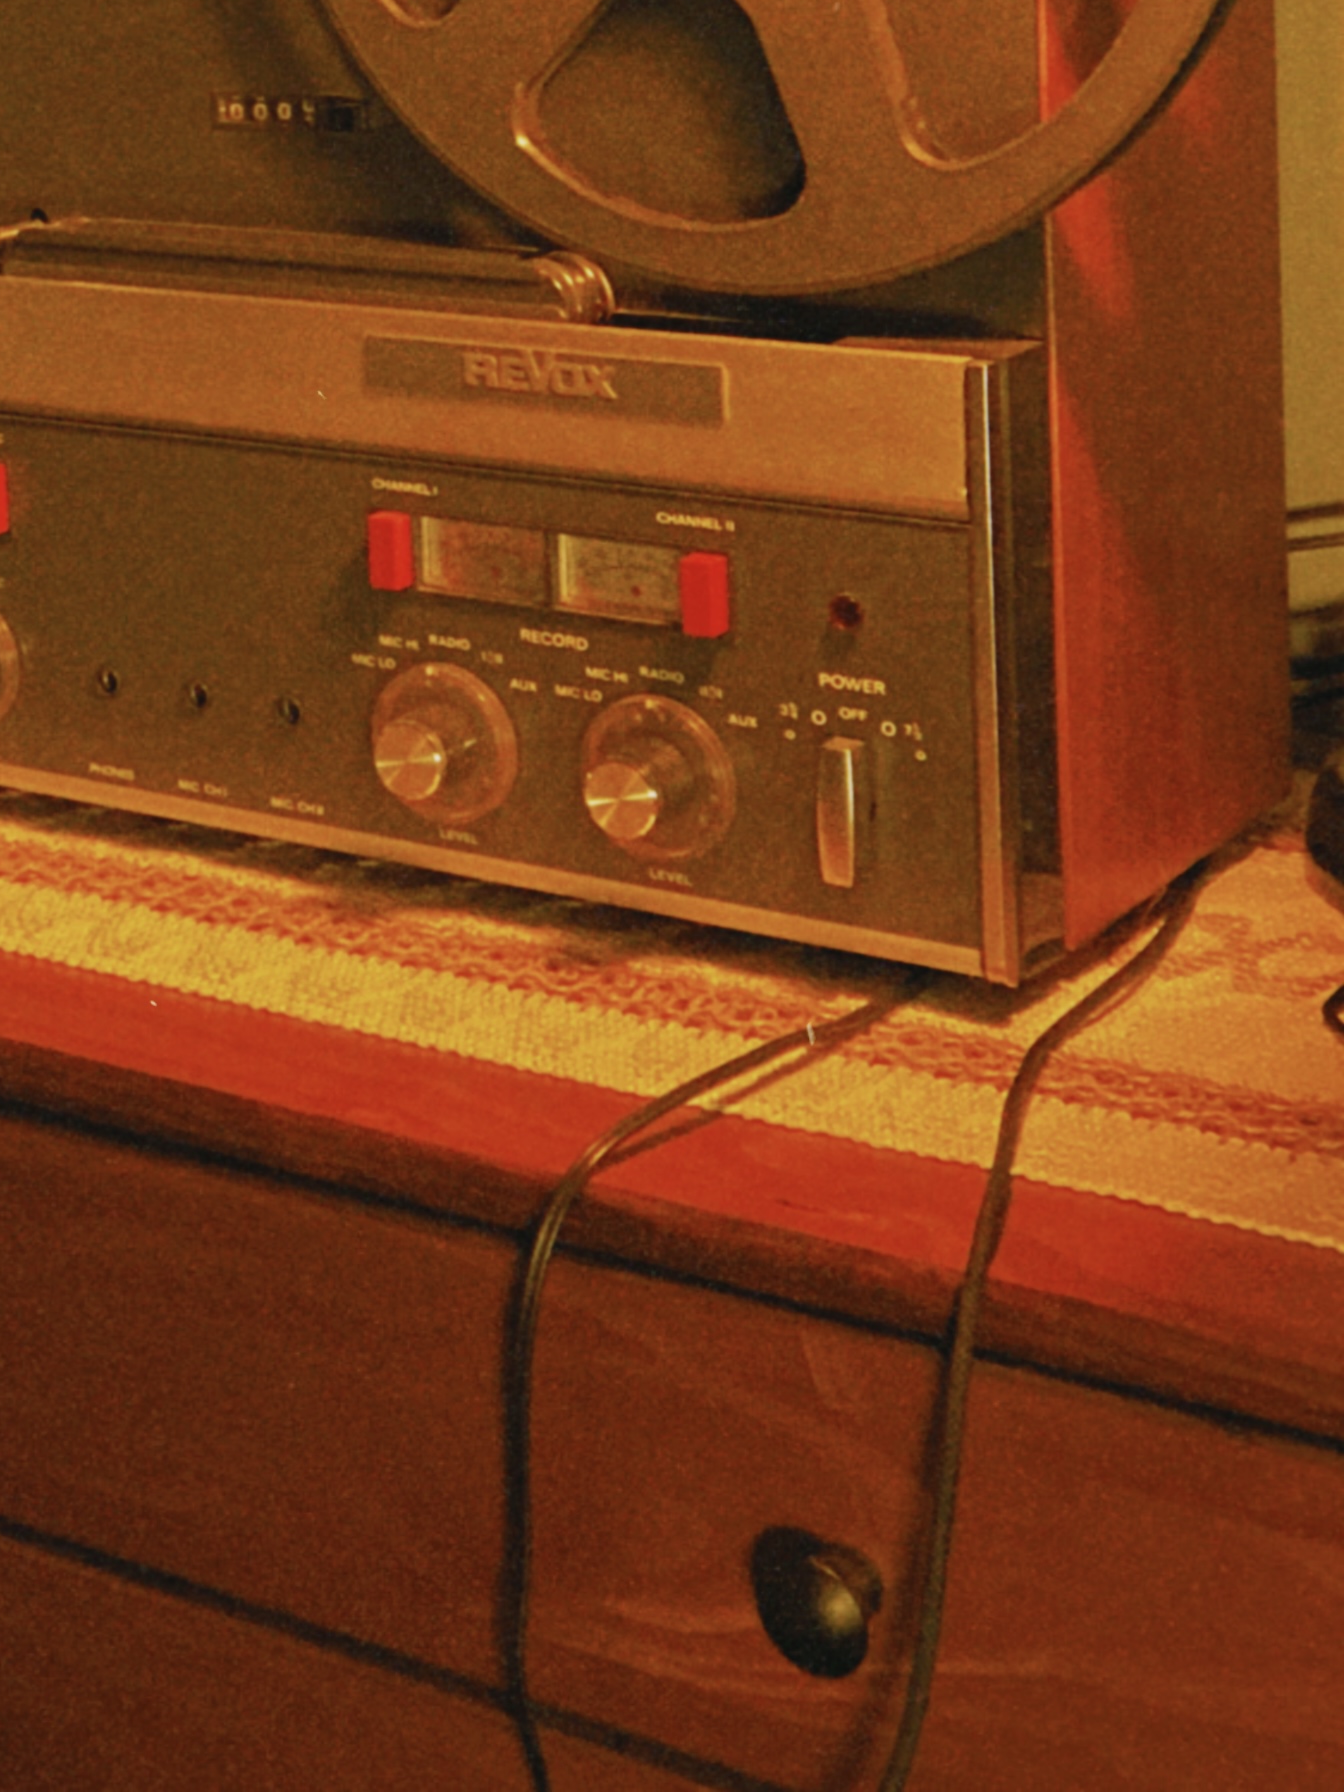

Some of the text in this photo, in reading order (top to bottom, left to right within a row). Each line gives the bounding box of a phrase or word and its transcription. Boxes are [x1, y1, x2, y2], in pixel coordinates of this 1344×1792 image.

[462, 347, 619, 400] REVOX
[371, 476, 430, 496] CHANNEL
[656, 510, 722, 532] CHANNEL
[378, 634, 403, 649] MIC
[428, 633, 472, 651] RADIO
[519, 627, 589, 652] RECORD
[351, 652, 397, 670] MIC LO
[585, 665, 611, 682] MIC
[638, 665, 685, 684] RADIO
[509, 677, 537, 692] AUX
[554, 683, 603, 703] MIC LO
[818, 671, 886, 696] POWER
[728, 713, 758, 728] AUX
[838, 706, 868, 722] OFF
[88, 761, 136, 781] PHONES
[177, 778, 200, 794] MIC
[269, 796, 292, 810] MIC
[438, 827, 478, 846] LEVEL
[649, 866, 693, 887] LEVEL
